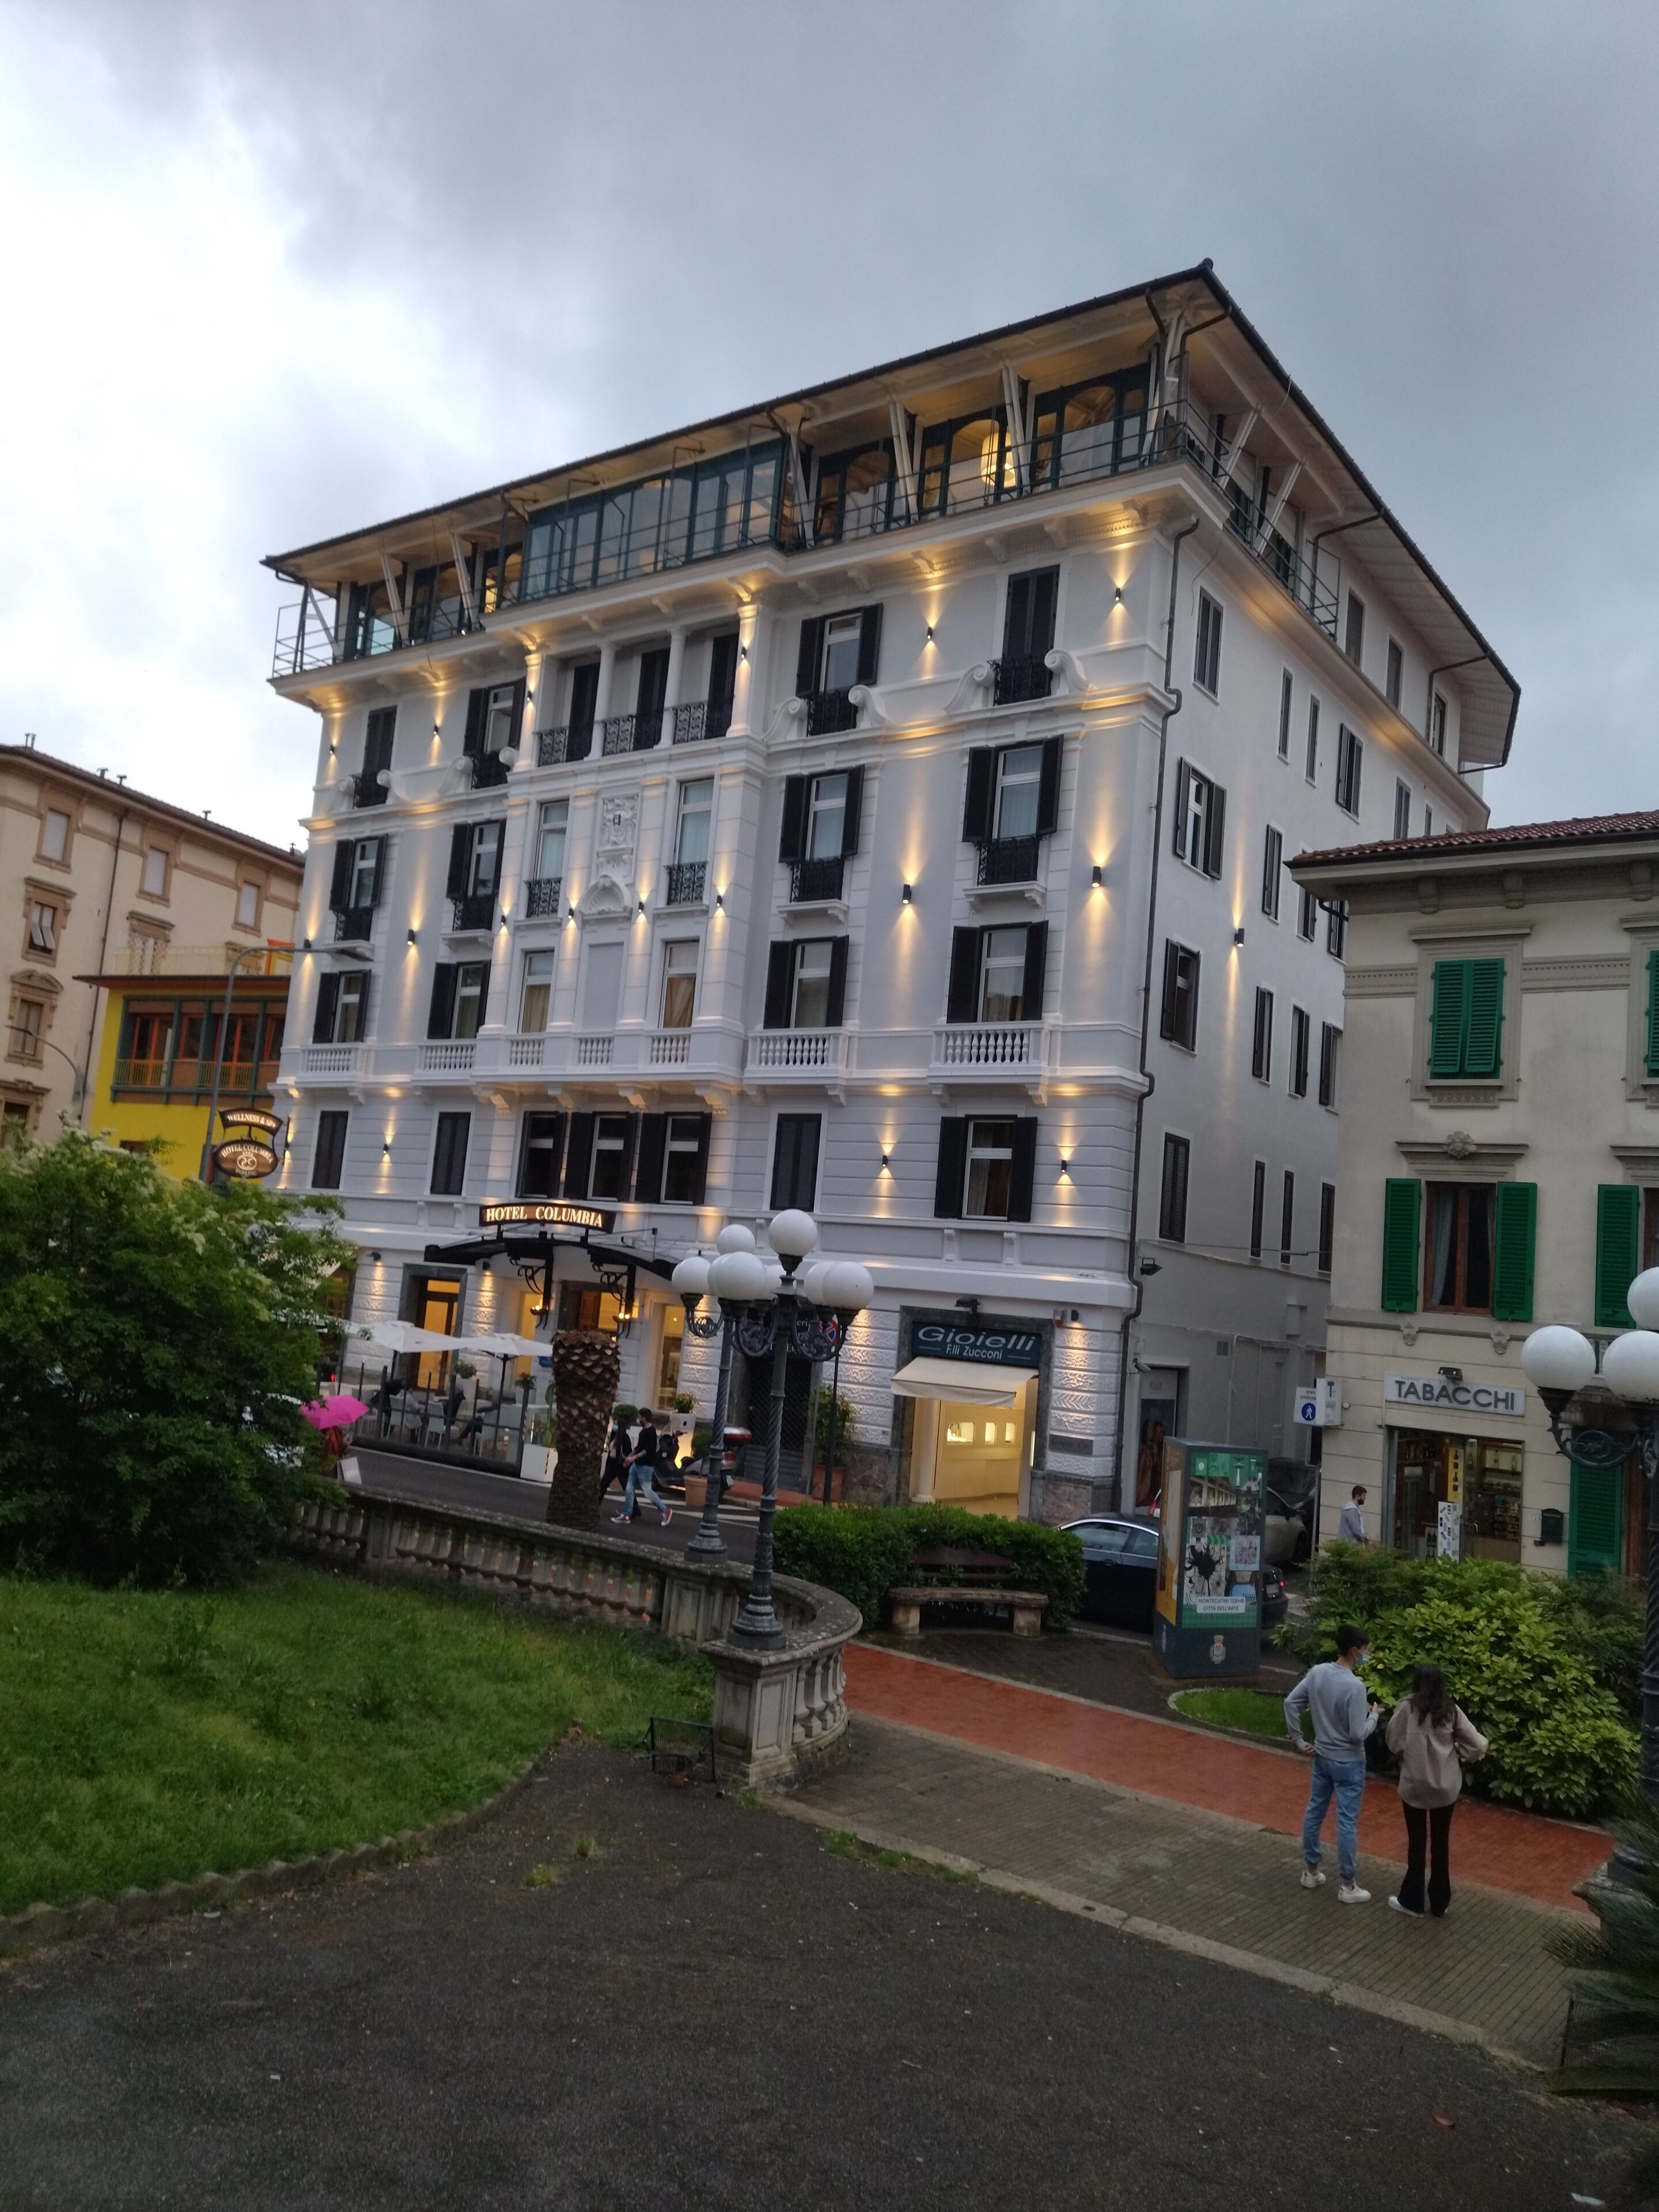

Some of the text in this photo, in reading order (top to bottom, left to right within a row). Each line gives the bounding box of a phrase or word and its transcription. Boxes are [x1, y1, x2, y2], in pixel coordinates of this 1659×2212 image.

[227, 1113, 260, 1123] WELLNESS
[266, 1119, 275, 1129] SPA
[221, 1143, 273, 1164] HOTEL COLUMBIA
[486, 1206, 603, 1228] HOTEL COLUMBIA
[918, 1327, 1036, 1351] Gioielli
[946, 1344, 1003, 1359] F.lli Zucconi
[1395, 1380, 1514, 1410] TABACCHI
